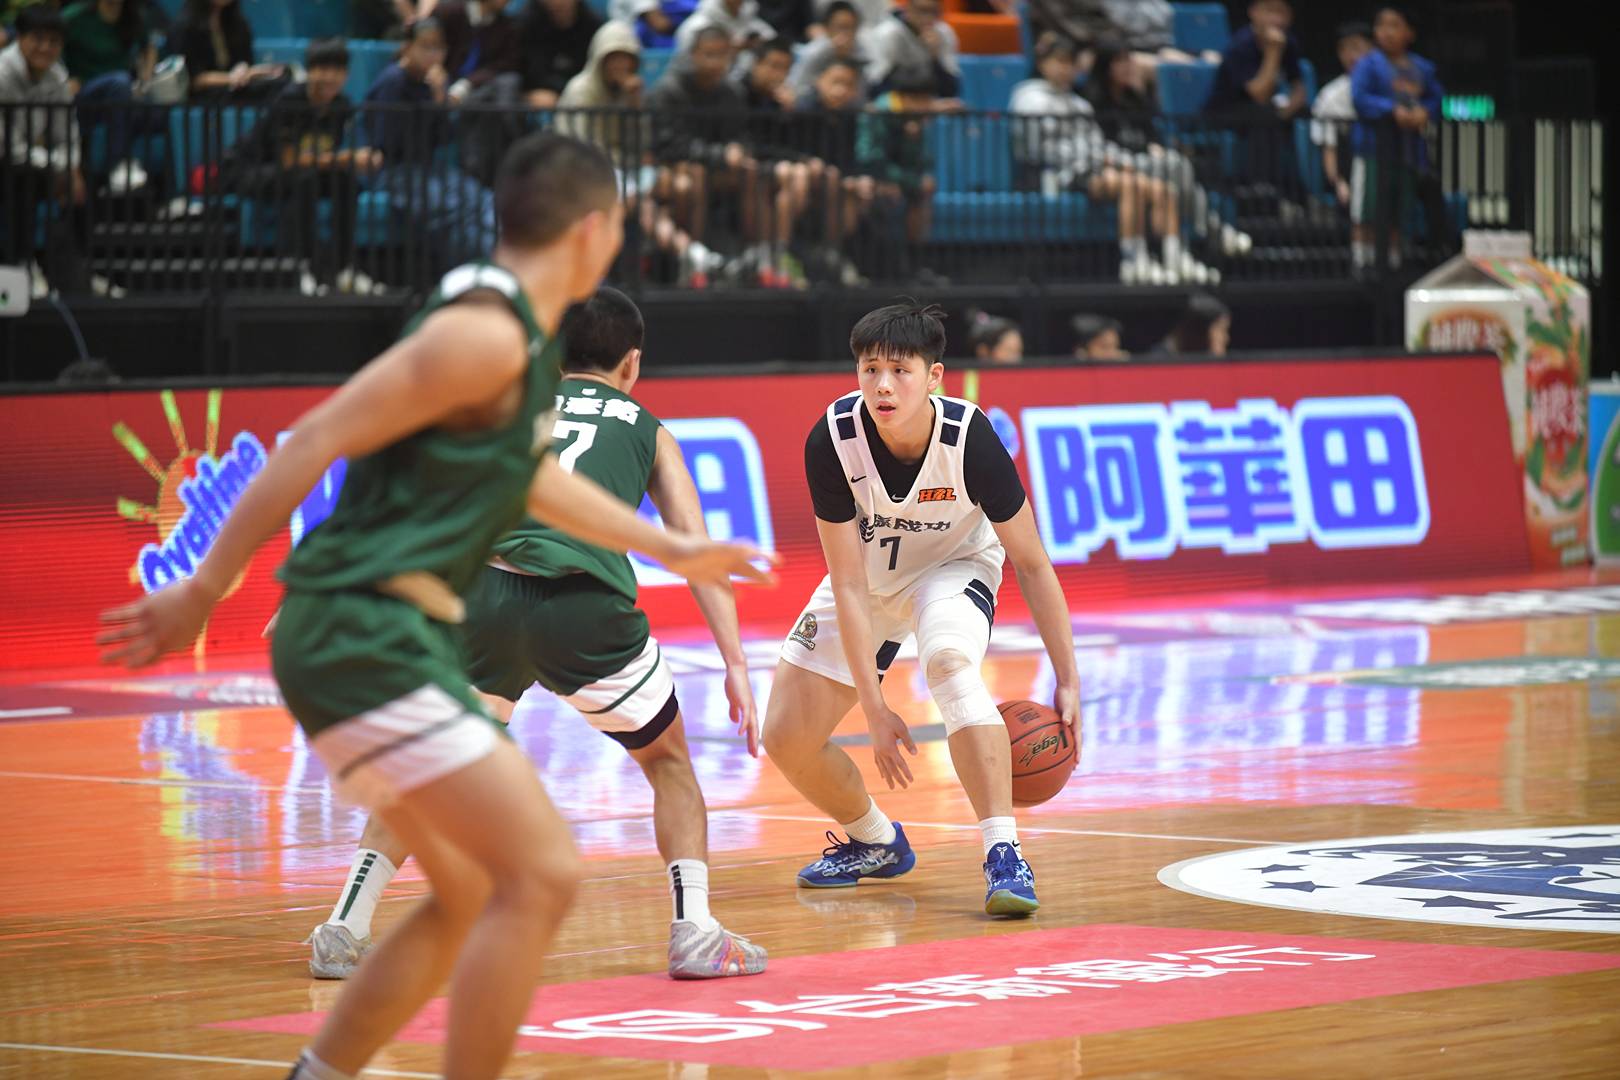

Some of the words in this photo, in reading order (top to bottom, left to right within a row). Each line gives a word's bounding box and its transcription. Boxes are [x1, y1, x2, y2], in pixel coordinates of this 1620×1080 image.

[552, 419, 598, 476] 7
[1022, 396, 1430, 563] 阿華田
[879, 535, 902, 571] 7
[735, 943, 1377, 1019] 台新銀行
